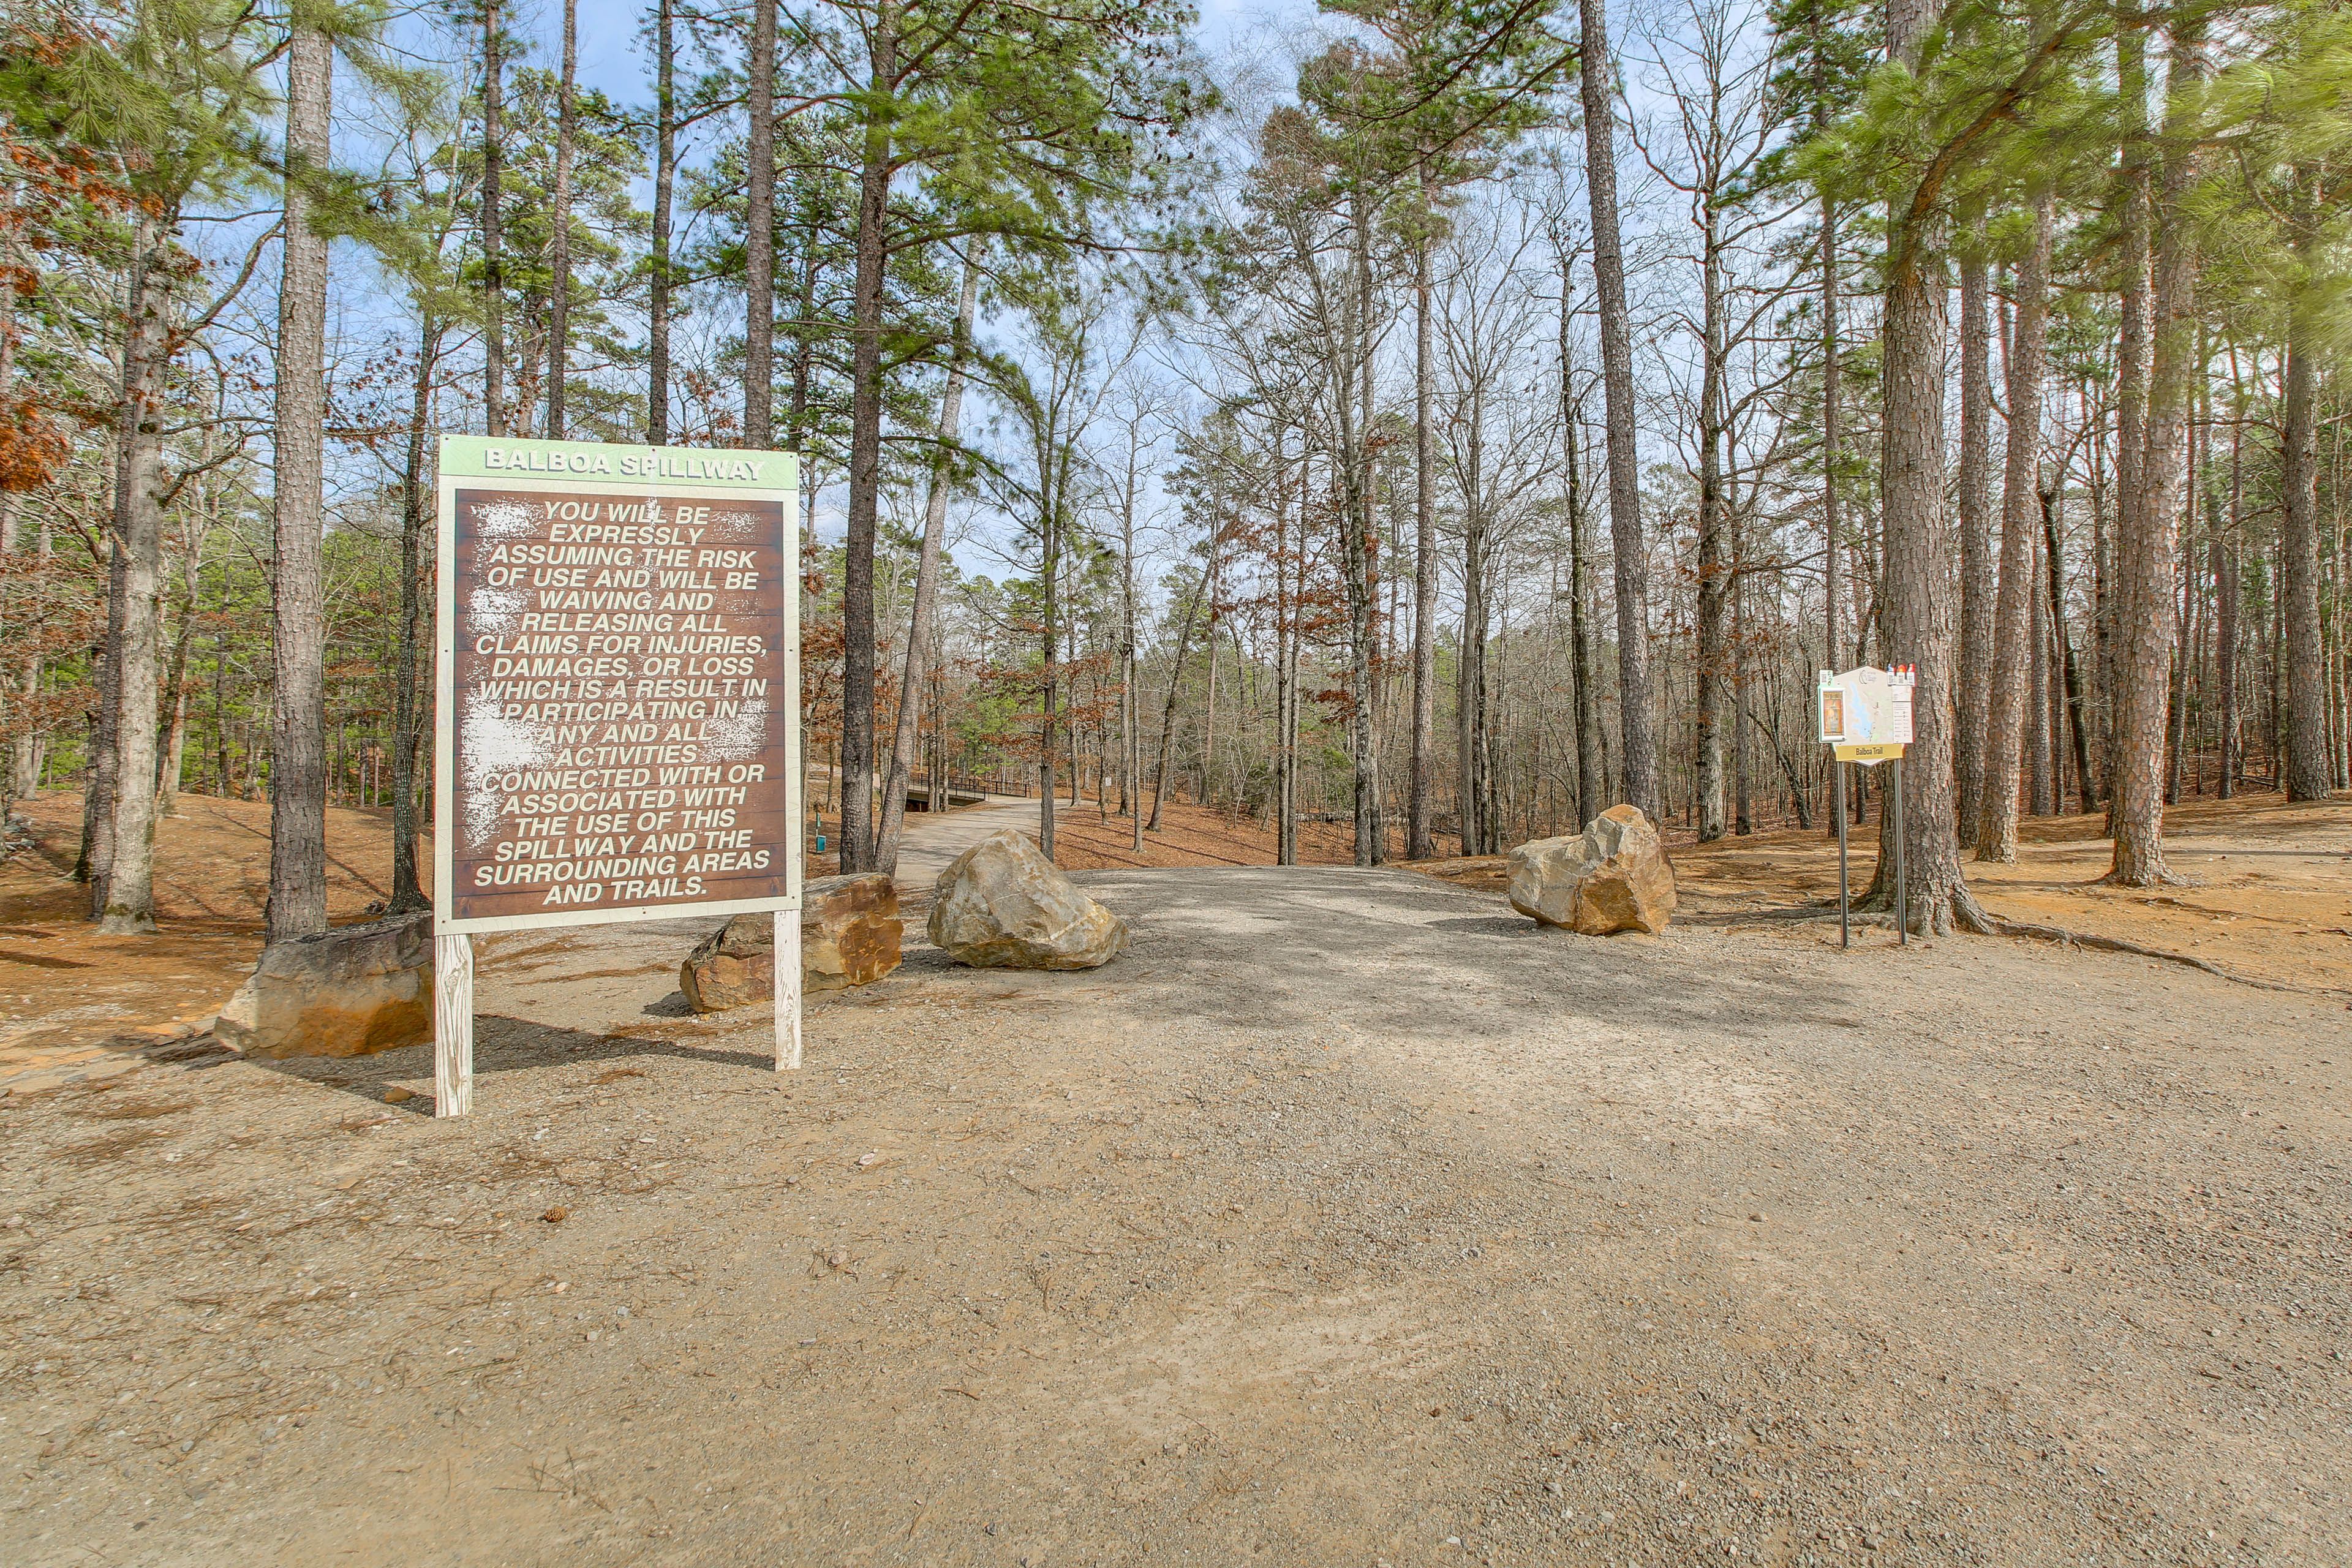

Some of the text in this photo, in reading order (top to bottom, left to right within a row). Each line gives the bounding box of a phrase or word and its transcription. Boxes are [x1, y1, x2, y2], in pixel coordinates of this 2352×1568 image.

[485, 449, 766, 481] BALBOA SPILLWAY
[544, 501, 710, 525] YOU WILL BE
[549, 525, 705, 546] EXPRESSLY
[489, 545, 756, 568] ASSUMING THE RISK
[488, 567, 759, 590] OF USE AND WILL BE
[540, 590, 713, 611] WAIVING AND
[521, 614, 727, 632] RELEASING ALL
[475, 635, 767, 657] CLAIMS FOR INJURIES,
[492, 657, 753, 679] DAMAGES, OR LOSS
[480, 679, 767, 700] WHICH IS A RESULT IN
[503, 700, 737, 722] PARTICIPATING IN
[537, 723, 713, 745] ANY AND ALL
[552, 744, 698, 767] ACTIVITIES
[481, 764, 765, 794] CONNECTED WITH OR
[500, 786, 745, 815] ASSOCIATED WITH
[515, 809, 736, 838] THE USE OF THIS
[495, 829, 753, 862] SPILLWAY AND THE
[474, 850, 770, 886] SURROUNDING AREAS
[543, 876, 707, 905] AND TRAILS.
